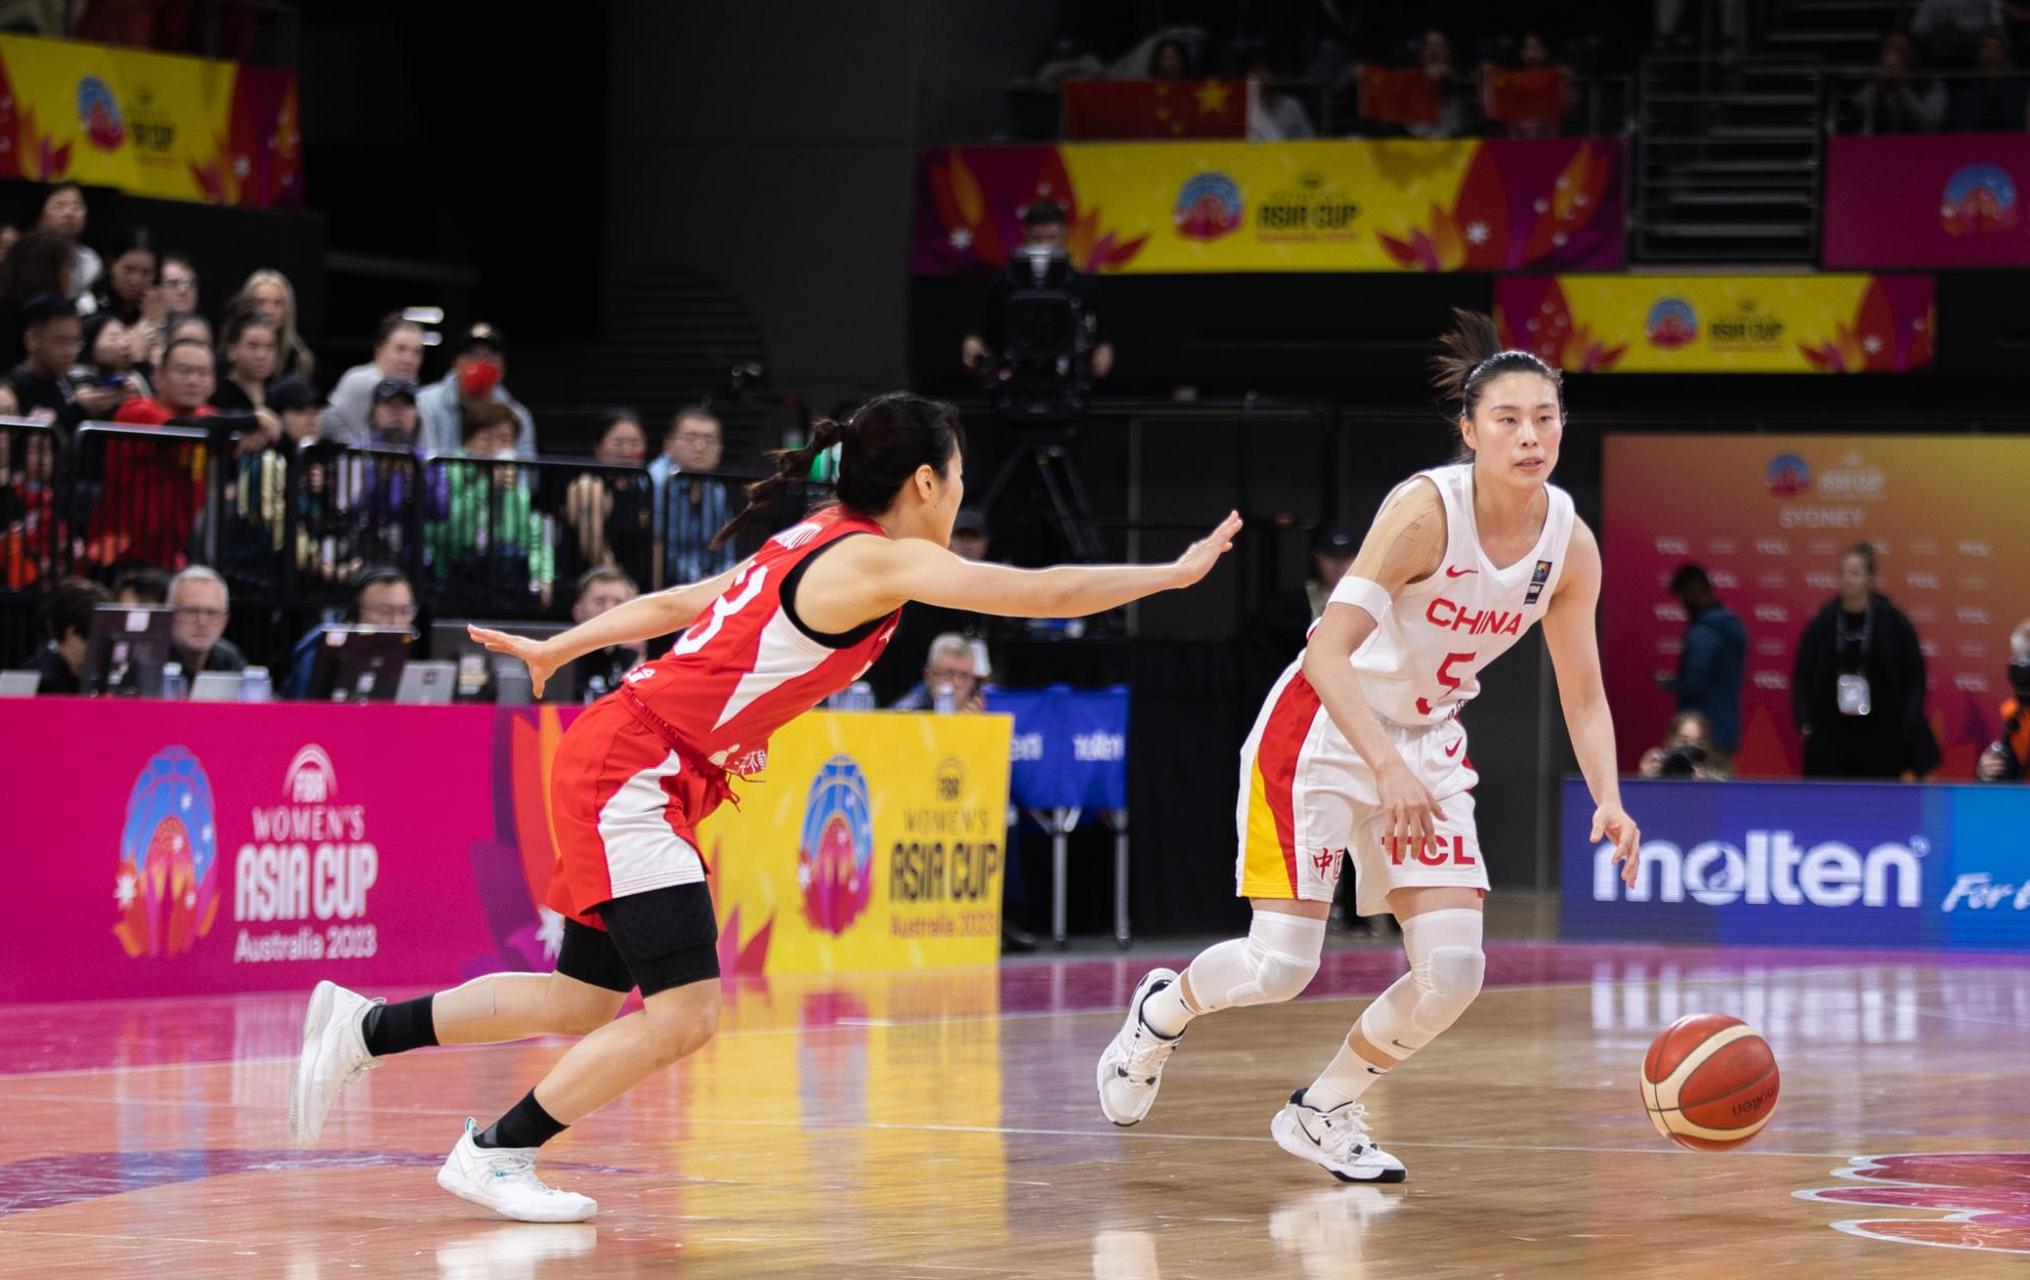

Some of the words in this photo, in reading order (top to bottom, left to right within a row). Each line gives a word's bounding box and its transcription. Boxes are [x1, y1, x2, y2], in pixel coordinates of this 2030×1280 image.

[1425, 598, 1523, 635] CHINA
[1415, 651, 1477, 715] 5
[252, 804, 366, 841] WOMEN'S
[903, 809, 990, 835] WOMEN'S
[234, 842, 310, 922] ASIA
[313, 842, 379, 920] CUP
[889, 841, 945, 903] ASIA
[950, 841, 998, 902] CUP
[1593, 829, 1921, 908] molten
[1941, 871, 2014, 913] For
[234, 925, 325, 963] Australia
[326, 923, 378, 959] 2023
[890, 913, 955, 938] Australia
